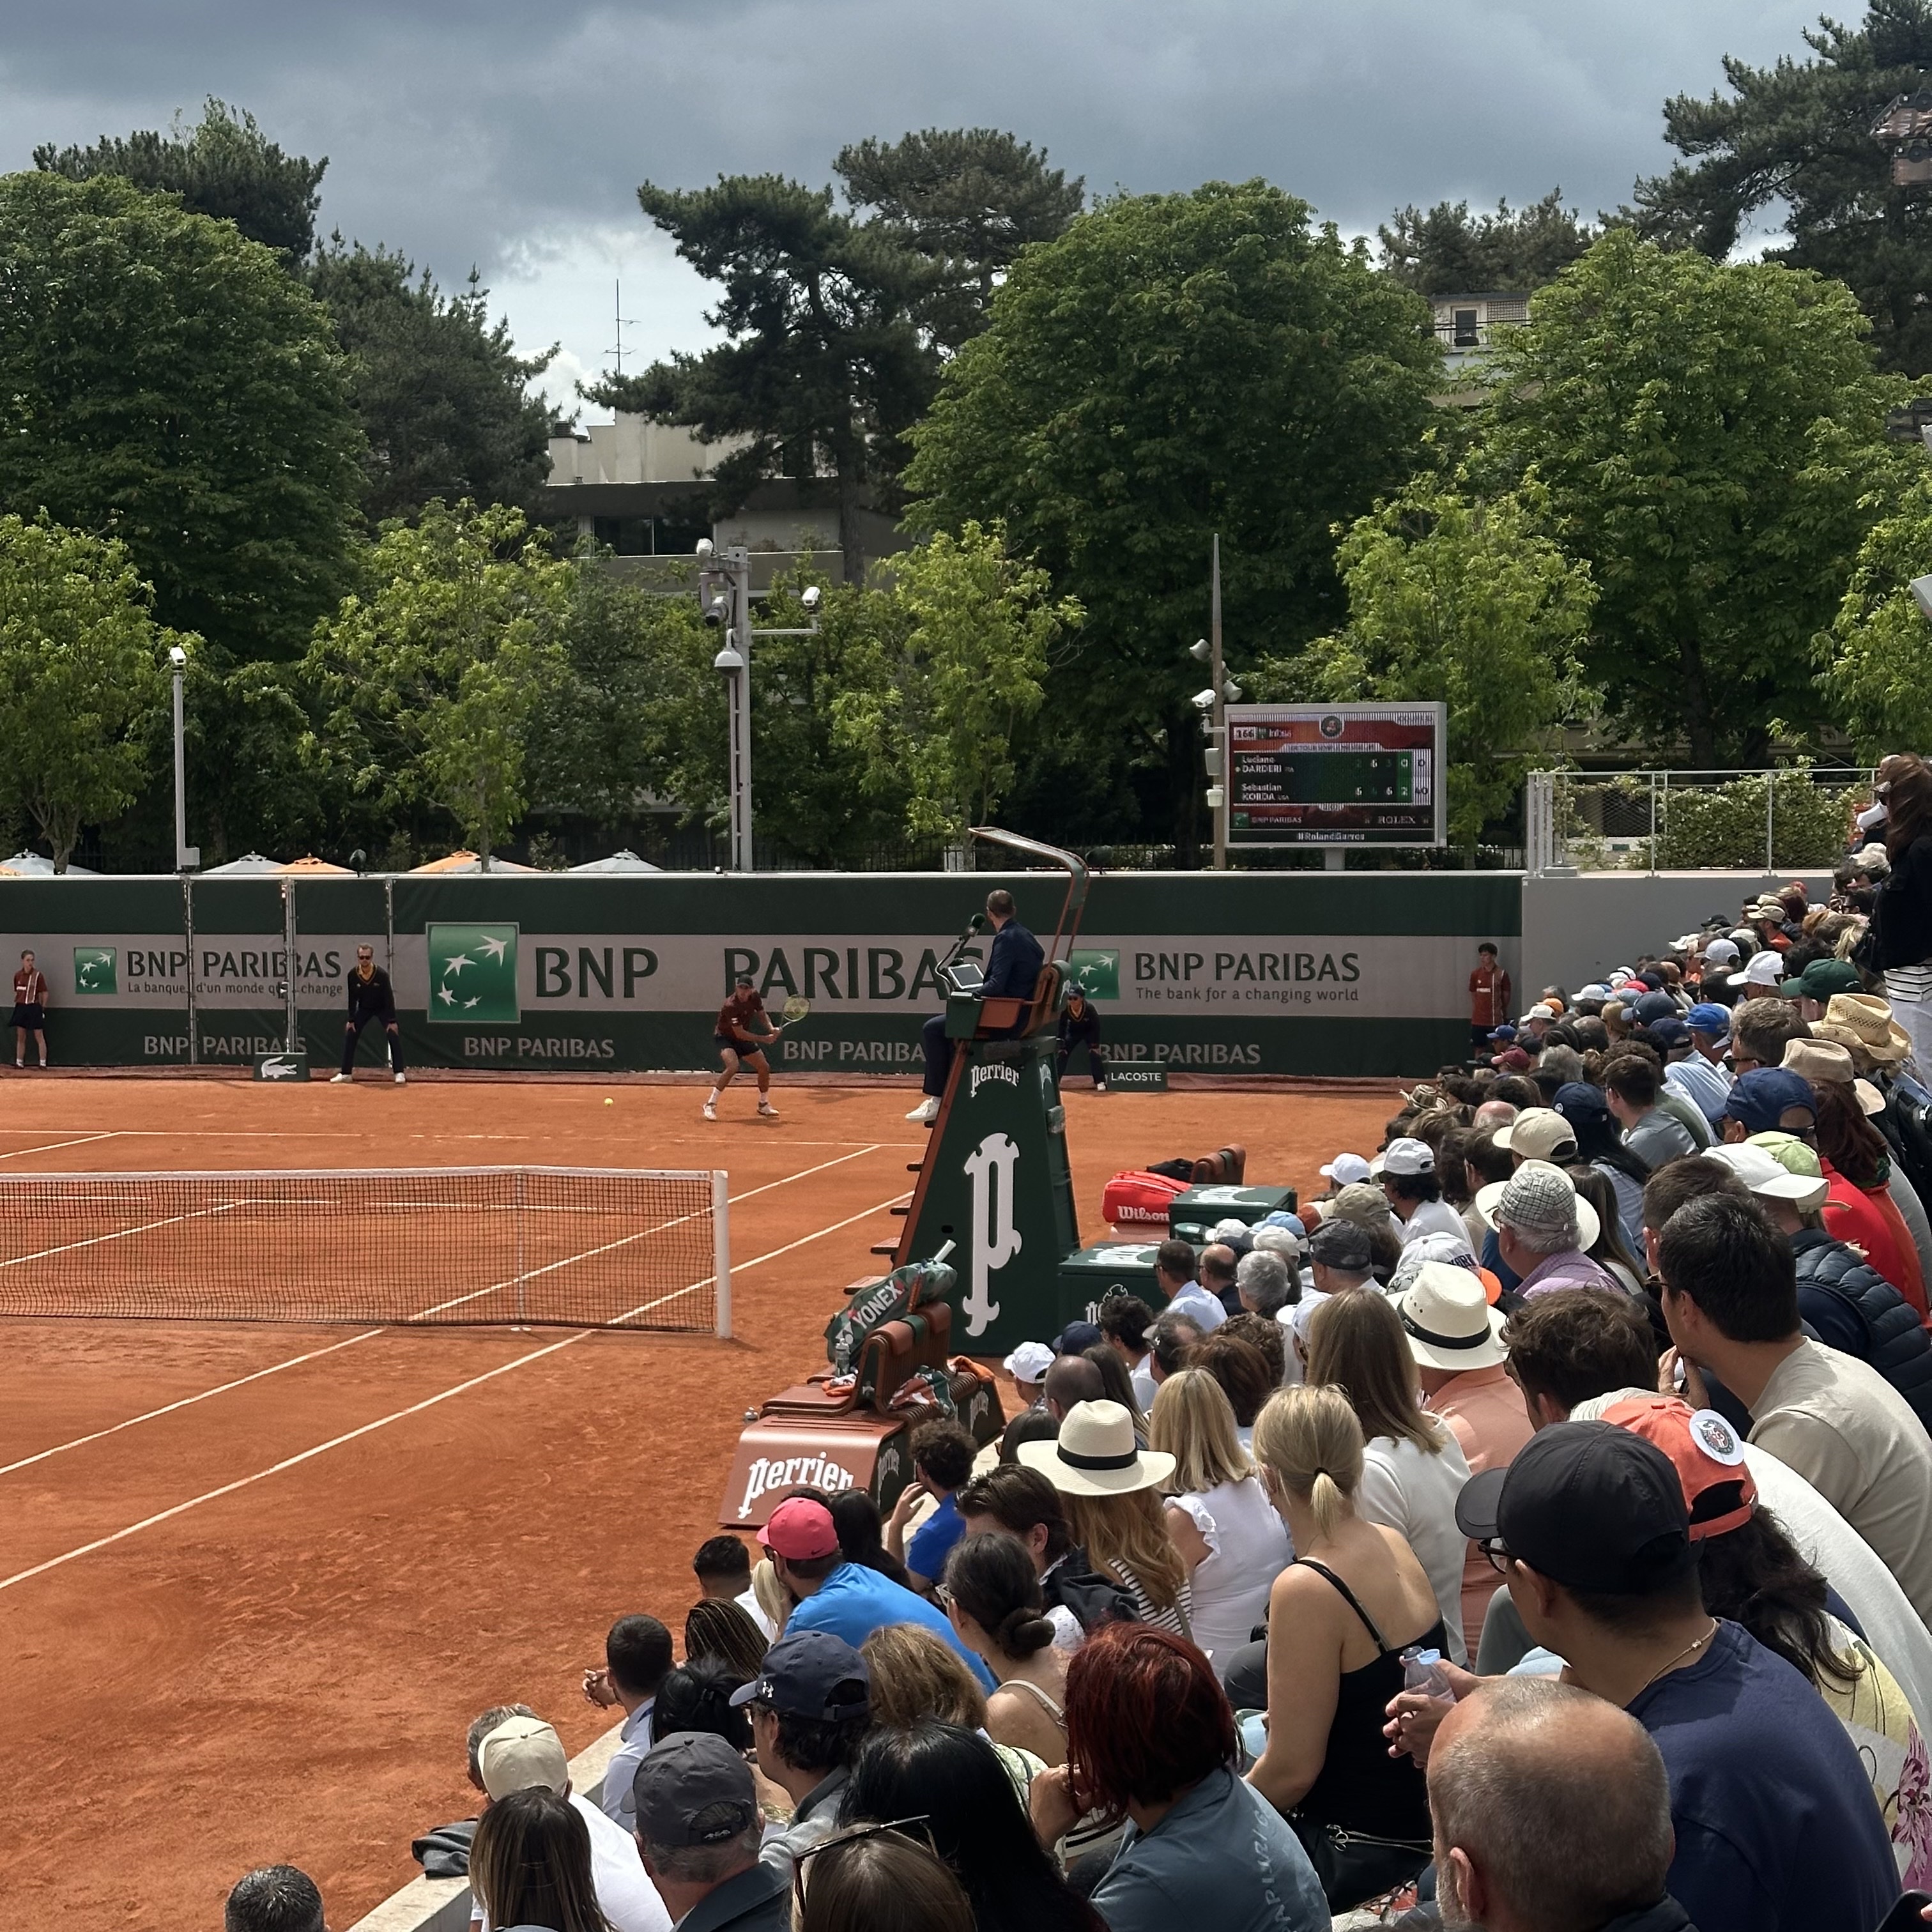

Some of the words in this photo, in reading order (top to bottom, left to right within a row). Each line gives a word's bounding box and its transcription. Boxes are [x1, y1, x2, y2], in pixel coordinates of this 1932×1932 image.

[1242, 755, 1275, 763] Luciano
[1242, 765, 1282, 773] DARDERI
[1242, 783, 1282, 792] Sebastian
[1378, 816, 1416, 824] ROLEX
[127, 951, 187, 977] BNP
[203, 951, 342, 978] PARIBAS
[535, 947, 659, 998] BNP
[1135, 953, 1204, 981] BNP
[1215, 952, 1360, 982] PARIBAS
[128, 982, 140, 993] La
[144, 982, 186, 995] banque
[196, 982, 221, 993] d'un
[226, 982, 264, 993] monde
[301, 982, 342, 997] change
[1136, 987, 1161, 999] The
[1167, 987, 1201, 1000] bank
[1206, 987, 1227, 1002] for
[1232, 990, 1240, 1000] a
[1246, 988, 1311, 1004] changing
[1317, 988, 1359, 1000] world
[144, 1036, 188, 1054] BNP
[464, 1037, 511, 1055] BNP
[518, 1038, 615, 1058] PARIBAS
[783, 1041, 832, 1060] BNP
[839, 1041, 926, 1062] PARIBA
[1099, 1043, 1147, 1063] BNP
[1154, 1043, 1262, 1064] PARIBAS
[1110, 1072, 1162, 1082] LACOSTE
[1117, 1205, 1170, 1223] Wilson
[851, 1279, 904, 1331] YONEX
